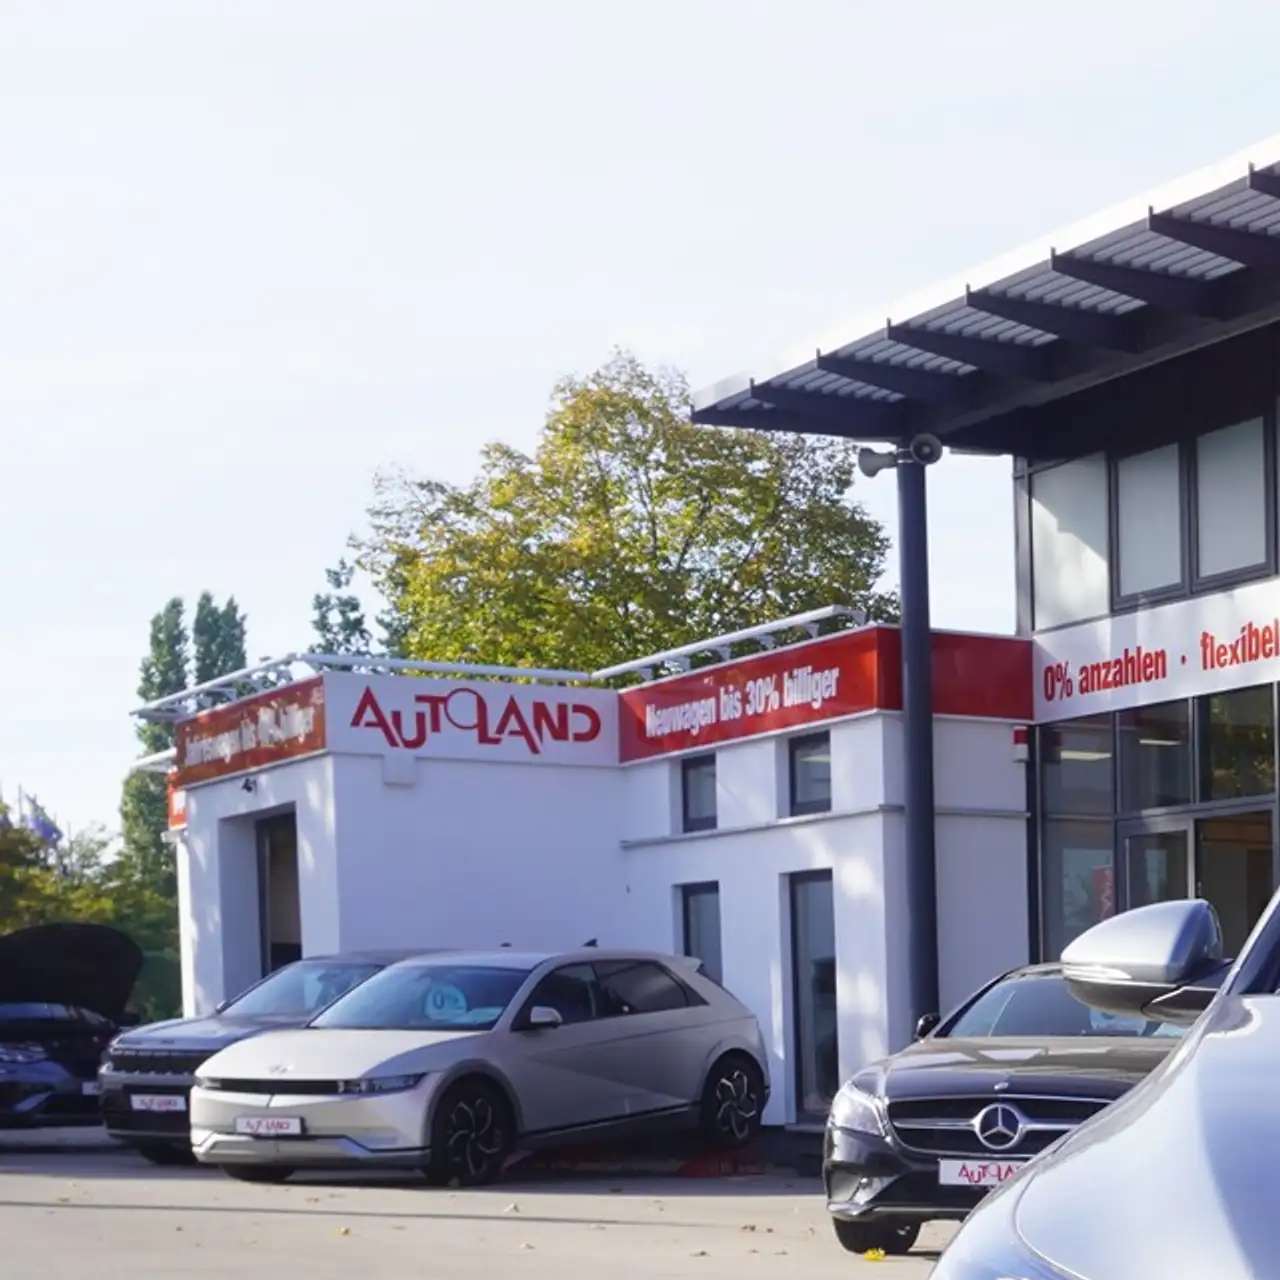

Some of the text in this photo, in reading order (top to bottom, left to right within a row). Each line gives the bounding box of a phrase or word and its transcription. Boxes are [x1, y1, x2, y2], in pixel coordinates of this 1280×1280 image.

[1043, 660, 1074, 702] 0%
[1078, 647, 1167, 697] anzahlen
[1200, 618, 1280, 671] flexibel
[350, 684, 601, 755] AUTOLAND
[645, 664, 840, 738] Neuwagen bis 30% billiger
[957, 1162, 1021, 1184] AUTOLA
